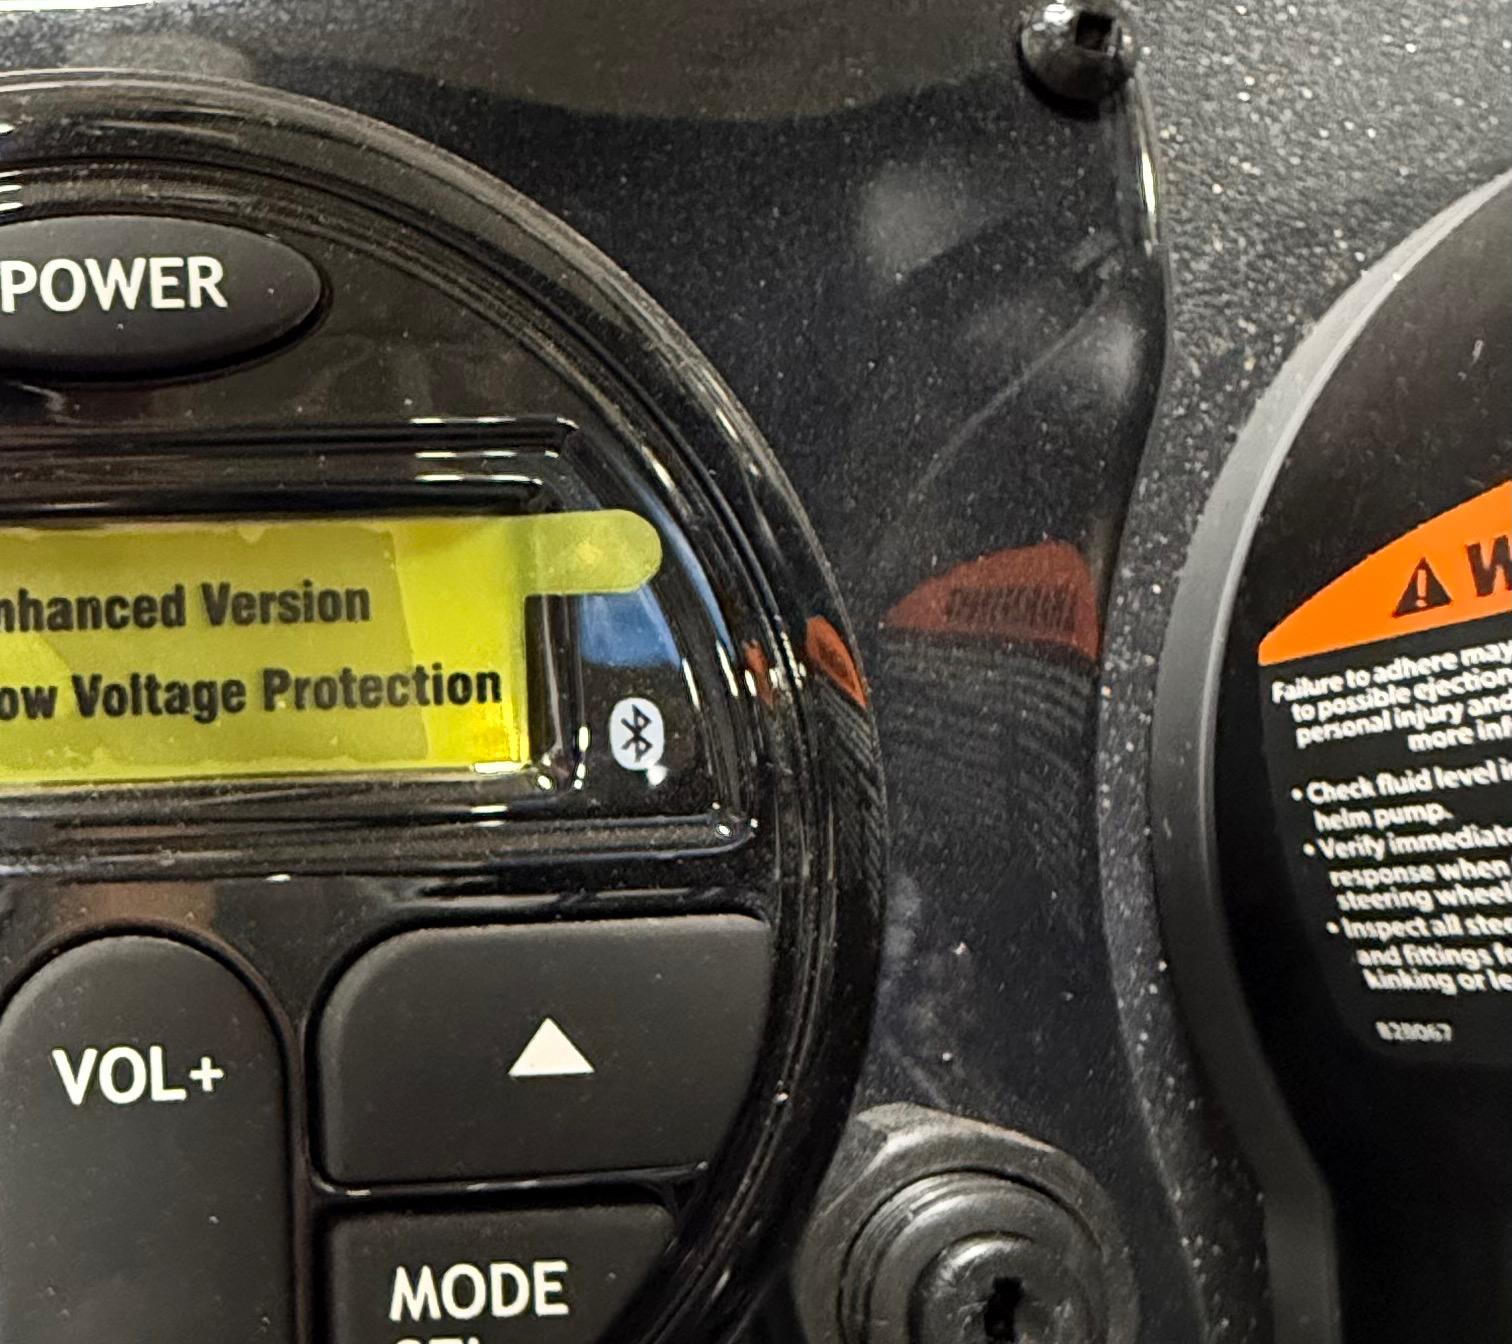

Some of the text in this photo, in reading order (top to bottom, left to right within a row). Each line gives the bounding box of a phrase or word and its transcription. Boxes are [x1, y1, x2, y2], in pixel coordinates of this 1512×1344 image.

[0, 256, 228, 312] POWER
[200, 581, 370, 626] Version
[74, 674, 248, 725] Voltage
[263, 664, 502, 711] Protection
[1272, 675, 1344, 703] Failure
[1346, 668, 1370, 688] to
[1373, 652, 1458, 682] adhere
[1291, 668, 1512, 722] to possible ejection
[1296, 709, 1392, 749] personal
[1394, 700, 1464, 730] injury
[1408, 725, 1473, 752] more
[1306, 775, 1376, 805] Check
[1376, 767, 1433, 796] fluid
[1433, 757, 1500, 789] level
[1313, 802, 1455, 833] helm pump.
[1316, 832, 1386, 862] Verify
[1329, 856, 1512, 890] response when
[1337, 886, 1435, 913] steering
[1341, 915, 1432, 942] Inspect
[1430, 912, 1465, 937] all
[1356, 944, 1403, 967] and
[1402, 941, 1496, 971] fittings
[1362, 967, 1458, 996] kinking
[1456, 972, 1487, 992] or
[53, 1047, 223, 1104] VOL+
[388, 1261, 570, 1320] MODE
